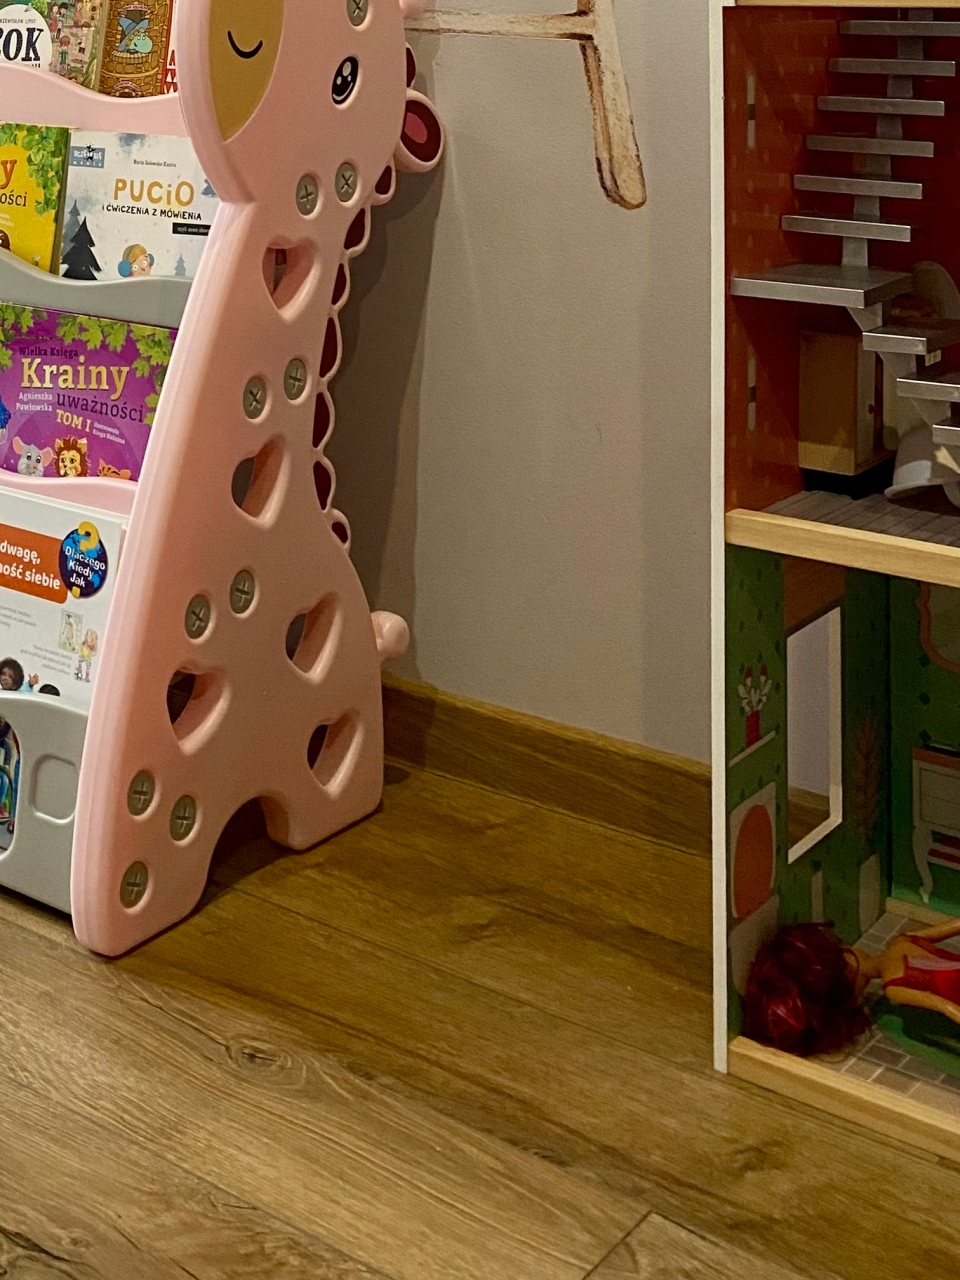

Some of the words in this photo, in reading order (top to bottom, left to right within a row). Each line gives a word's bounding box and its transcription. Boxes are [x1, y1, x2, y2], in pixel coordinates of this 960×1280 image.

[152, 208, 158, 217] Z
[19, 347, 48, 357] Wielka
[50, 348, 79, 360] Księga
[20, 355, 130, 402] Krainy
[16, 402, 53, 412] Pawłowska
[18, 391, 53, 402] Agnieszka
[57, 393, 144, 423] uważności
[56, 409, 82, 430] TOM
[85, 419, 92, 433] I
[64, 545, 106, 571] Dlaczego
[24, 570, 61, 591] siebie
[68, 559, 95, 581] Kiedy
[69, 574, 87, 589] Jak
